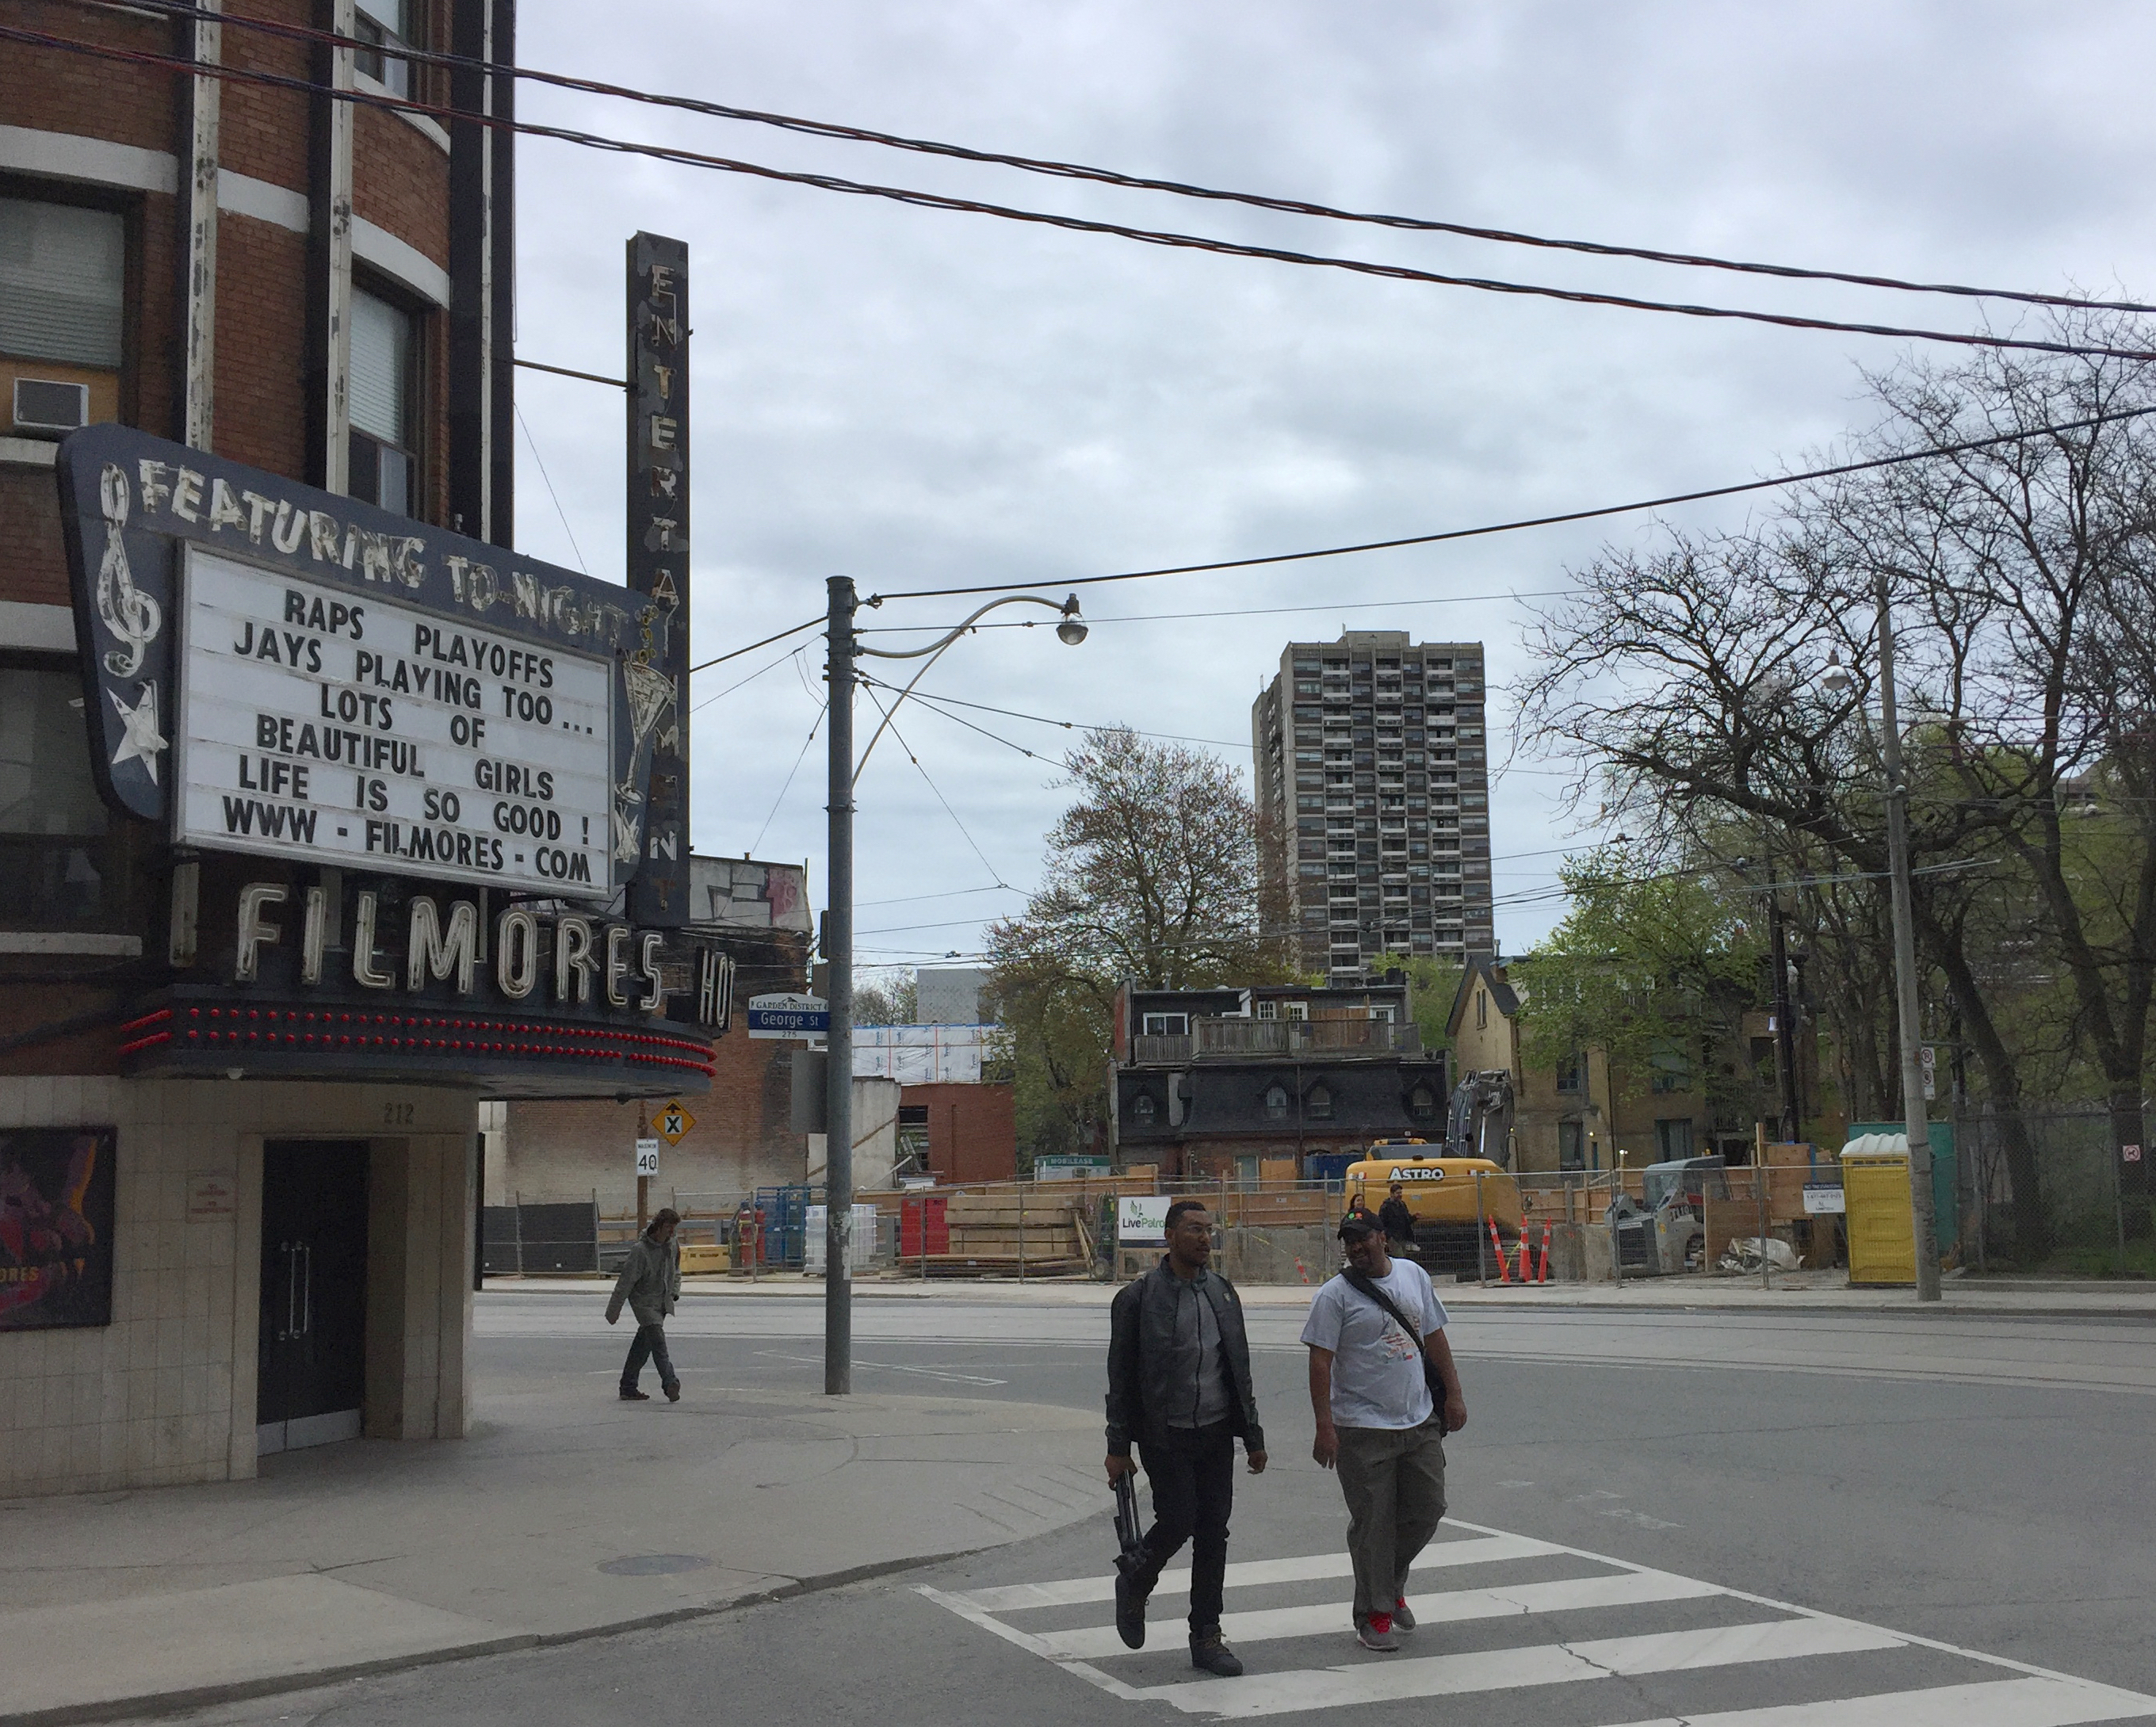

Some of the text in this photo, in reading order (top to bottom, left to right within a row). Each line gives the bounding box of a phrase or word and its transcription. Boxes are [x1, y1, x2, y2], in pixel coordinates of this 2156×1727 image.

[139, 458, 426, 588] FEATURING
[234, 622, 321, 673] JAYS
[357, 650, 481, 709] PLAYING
[285, 589, 553, 688] RAPS PLAYOFFS
[321, 682, 485, 747] LOTS OF
[239, 755, 309, 800] LIFE
[357, 775, 388, 812] IS
[423, 788, 460, 823] SO
[257, 713, 553, 801] BEAUTIFUL GIRLS
[223, 795, 317, 843] WWW
[366, 820, 503, 870] FILMORES
[536, 846, 591, 882] COM
[235, 882, 664, 1011] FILMORES
[755, 1001, 787, 1010] GARDEN
[761, 1011, 819, 1029] George St
[384, 1102, 414, 1125] 212
[666, 1116, 681, 1133] X
[639, 1154, 656, 1171] 40
[1388, 1167, 1444, 1181] ASTRO
[1122, 1217, 1165, 1228] LivePatro
